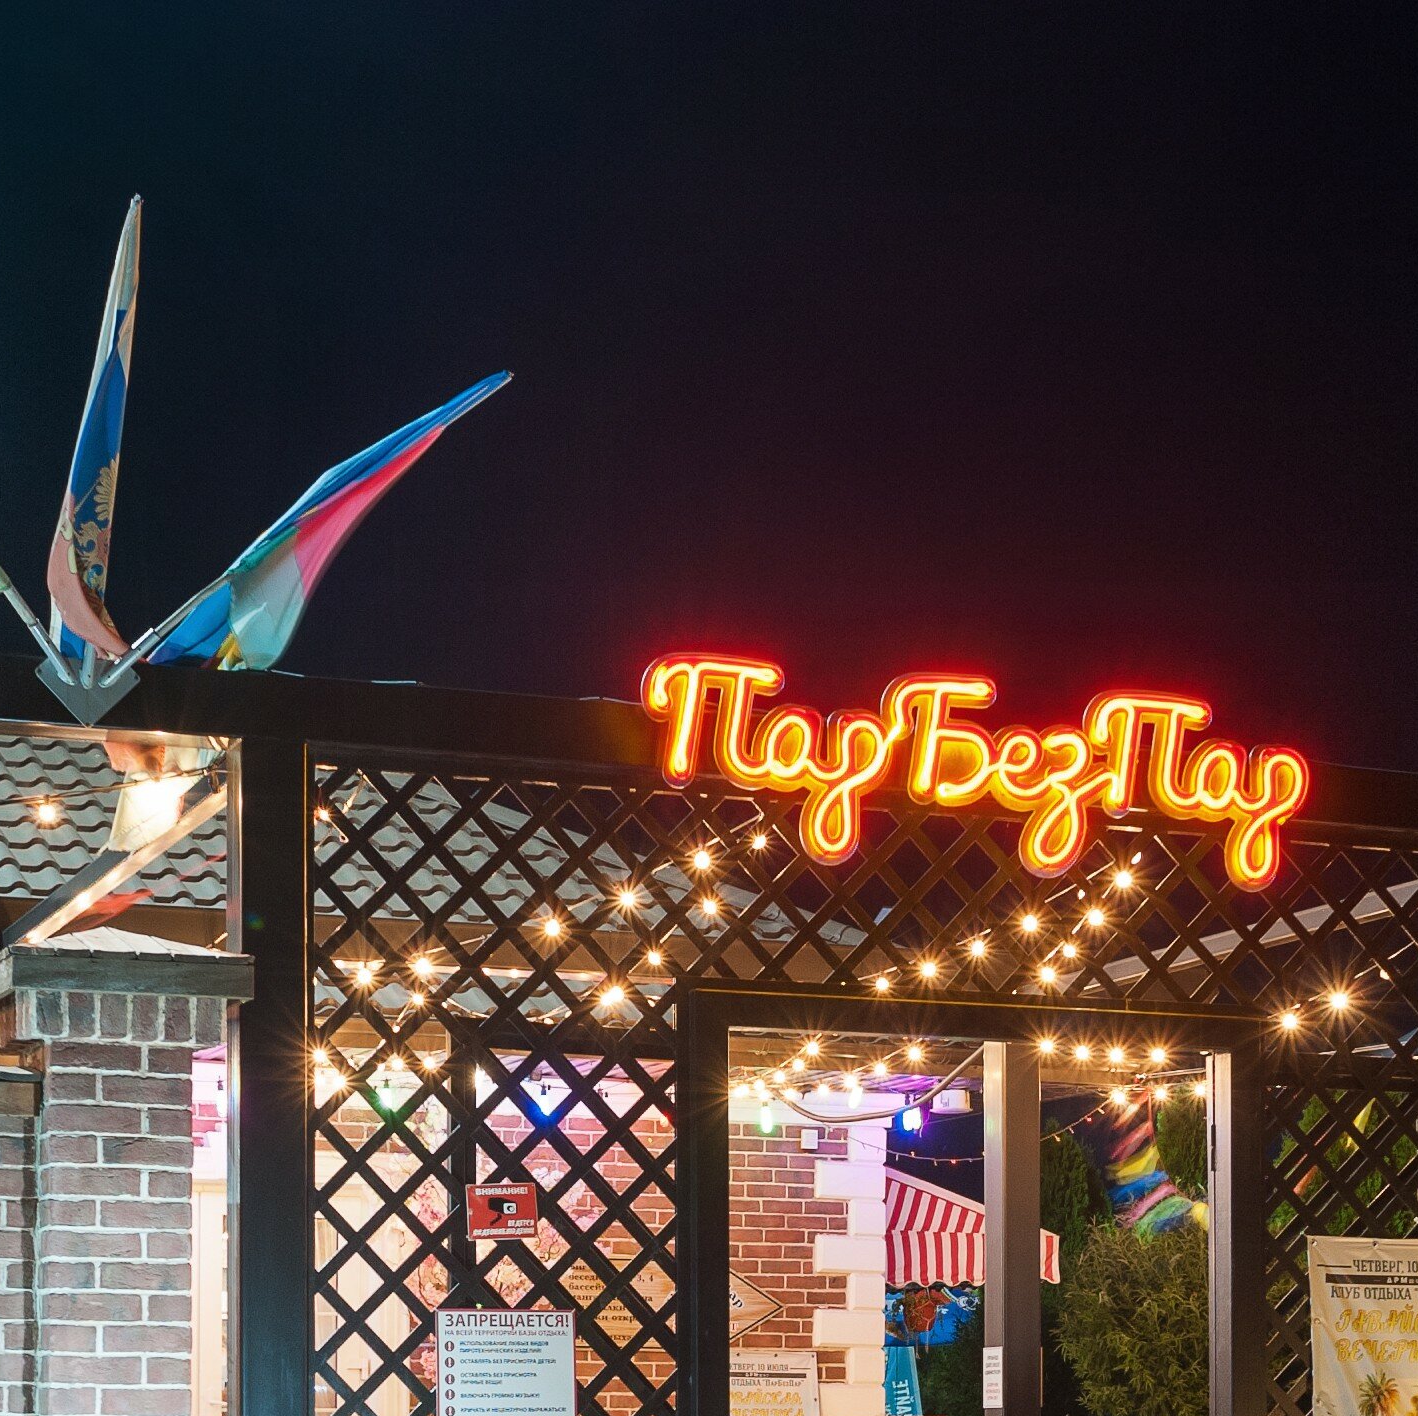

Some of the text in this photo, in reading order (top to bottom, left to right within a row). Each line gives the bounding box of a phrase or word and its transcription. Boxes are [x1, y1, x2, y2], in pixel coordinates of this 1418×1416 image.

[642, 653, 1308, 891] ПарБезПар
[1352, 1259, 1404, 1274] ЧЕТВЕРГ,
[1407, 1261, 1418, 1273] 10
[649, 1274, 654, 1282] 4
[1331, 1286, 1360, 1299] КЛУБ
[1364, 1287, 1412, 1301] ОТДЫХА
[445, 1314, 569, 1330] ЗАПРЕЩАЕТСЯ!
